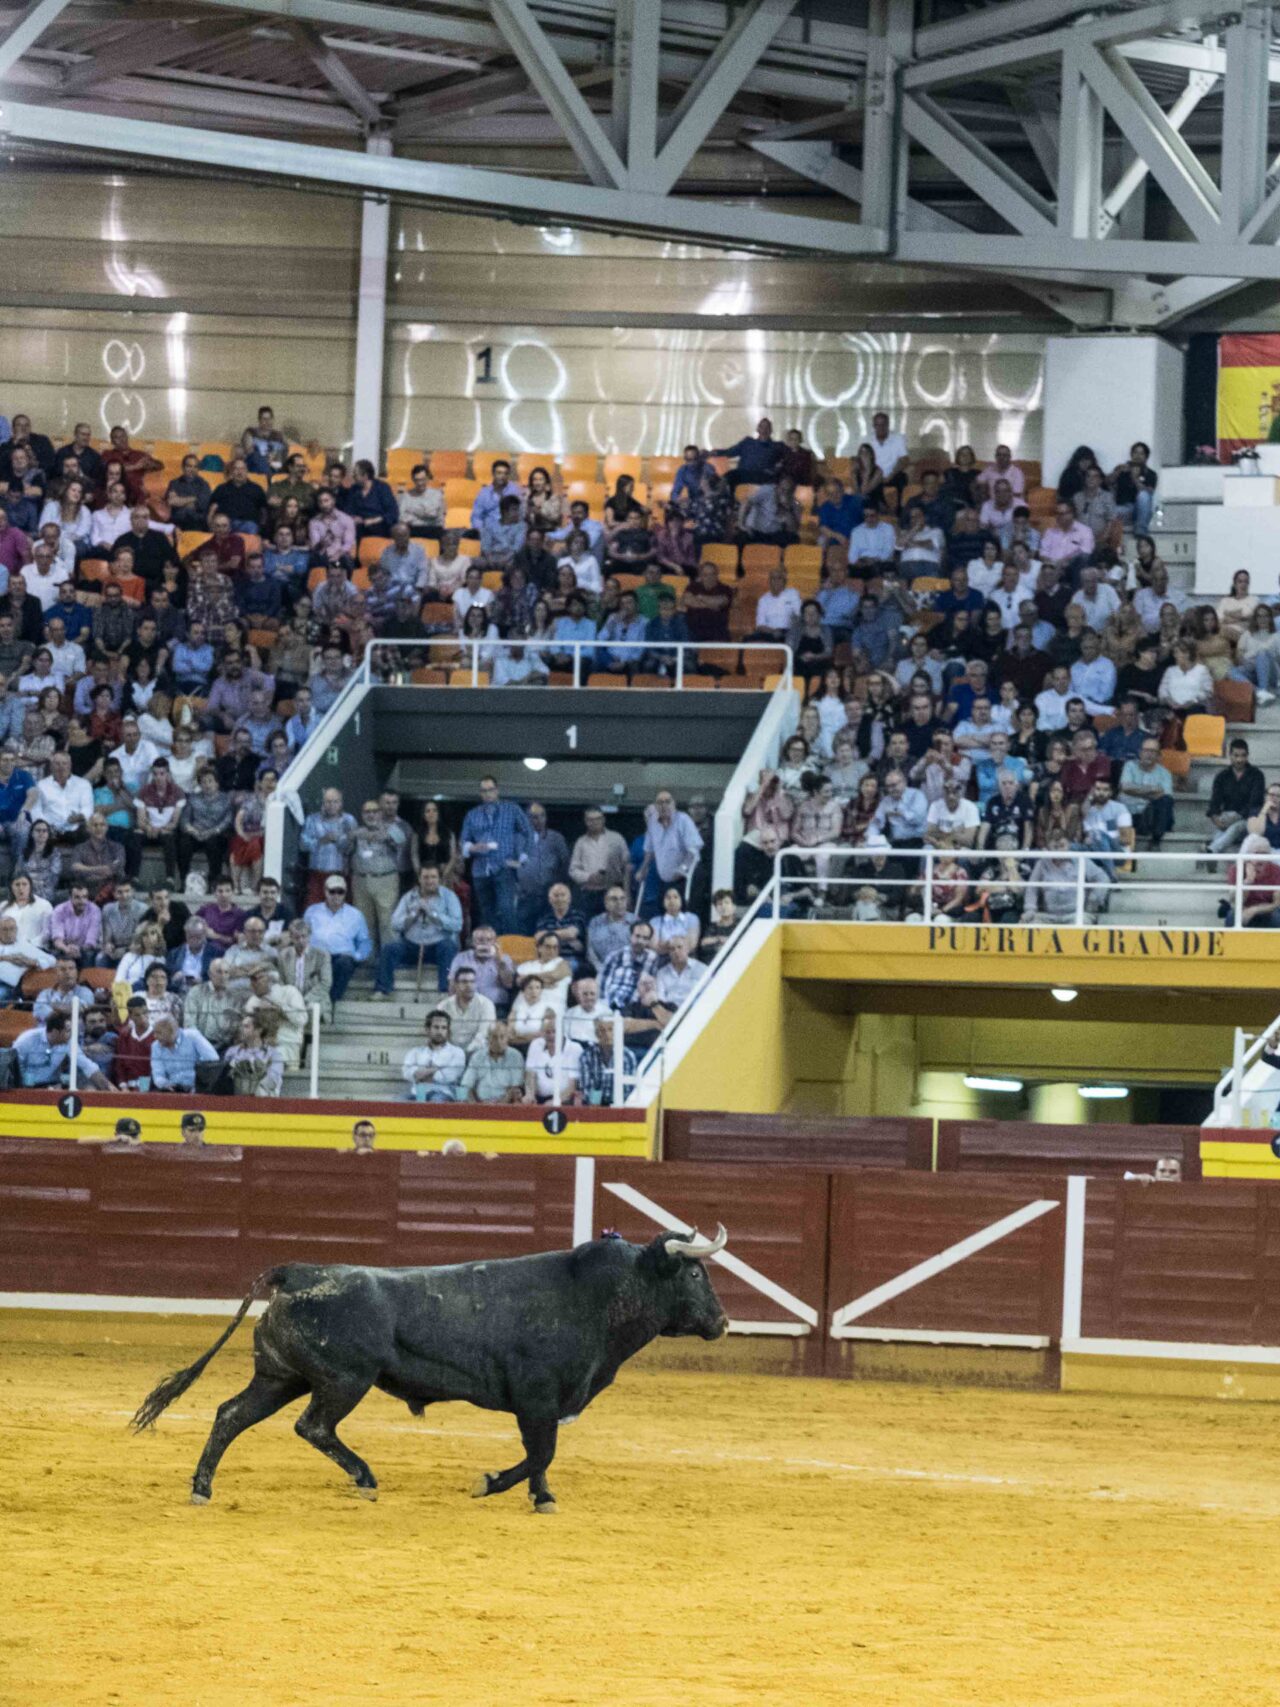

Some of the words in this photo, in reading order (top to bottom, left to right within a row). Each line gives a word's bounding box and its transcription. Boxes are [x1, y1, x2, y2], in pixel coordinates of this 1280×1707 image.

[476, 345, 497, 384] 1
[354, 711, 360, 736] 1
[566, 725, 578, 749] 1
[929, 926, 1064, 953] PUERTA
[1083, 929, 1225, 956] GRANDE
[367, 1051, 389, 1065] CB
[64, 1096, 74, 1117] 1
[548, 1111, 558, 1132] 1
